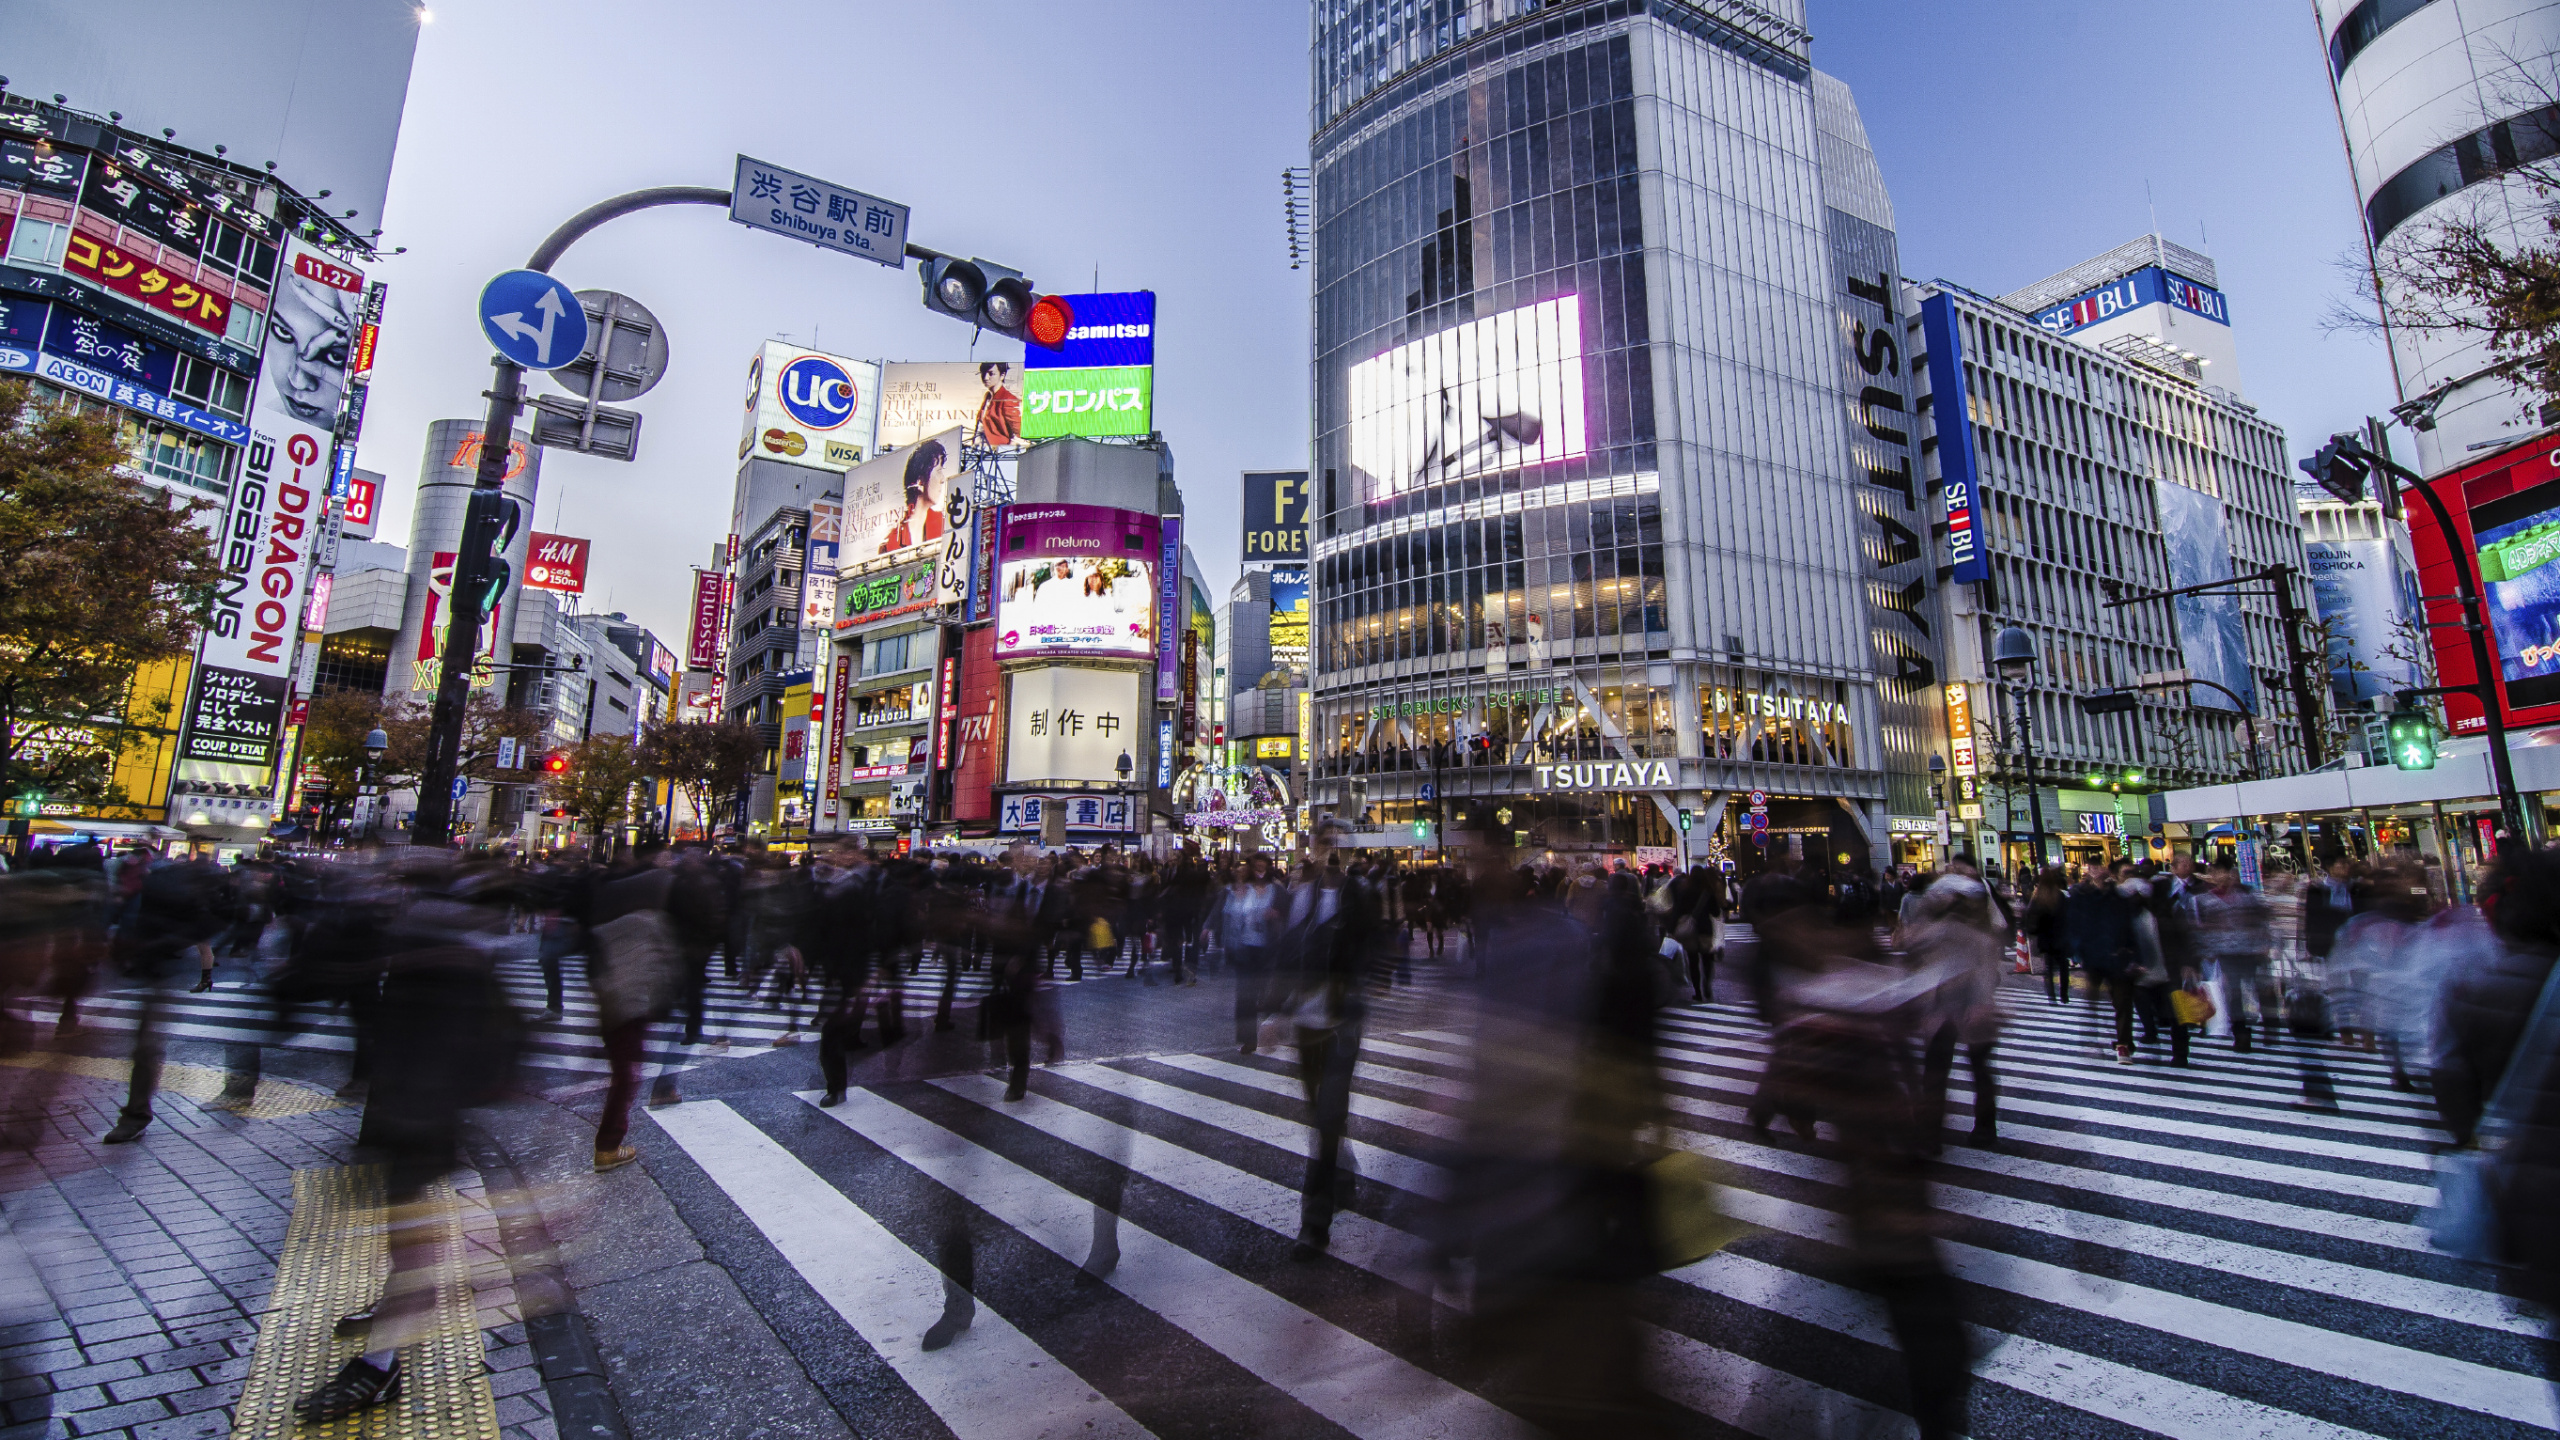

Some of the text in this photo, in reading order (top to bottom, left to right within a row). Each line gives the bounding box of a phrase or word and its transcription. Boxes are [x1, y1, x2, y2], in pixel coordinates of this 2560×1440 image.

[105, 166, 122, 178] 9F
[749, 169, 895, 238] 渋谷駅前
[770, 208, 875, 252] Shibuya Sta.
[28, 276, 48, 289] 7F
[68, 234, 223, 321] コンタクト
[305, 260, 352, 288] 11.27
[67, 286, 85, 299] 7F
[2167, 276, 2224, 321] SEIBU
[2040, 279, 2140, 333] SEIBU
[47, 360, 107, 393] AEON
[885, 381, 937, 393] 三浦大知
[788, 369, 851, 415] UC
[885, 393, 942, 401] NEW ALBUM
[885, 400, 917, 410] THE
[1028, 387, 1143, 414] サロンパス
[115, 383, 247, 440] 英会話イーオン
[254, 429, 276, 445] from
[764, 435, 807, 450] MasterCard
[829, 447, 861, 462] VISA
[1847, 271, 1936, 697] TSUTAYA
[1038, 510, 1067, 519] チャンネル
[1944, 481, 1976, 566] SEIBU
[245, 433, 319, 664] G-DRAGON
[323, 512, 341, 561] 渋谷駅前ビル
[941, 486, 970, 598] もんじゃ
[538, 539, 580, 566] H&M
[549, 576, 578, 588] 150m
[550, 568, 572, 577] この先
[814, 589, 835, 601] まで
[868, 583, 900, 610] 西村
[1160, 538, 1178, 652] Taisei neon
[691, 573, 719, 664] Essential
[1271, 654, 1291, 662] ALL
[205, 670, 257, 689] ジャパン
[199, 699, 241, 716] にして
[202, 685, 276, 706] ソロデビュー
[1372, 686, 1563, 721] STARBUCKS COFFEE
[858, 708, 910, 727] Euphoria
[1747, 693, 1852, 726] TSUTAYA
[195, 714, 272, 736] 完全ベスト!
[1030, 708, 1121, 739] 制作中
[191, 738, 268, 756] COUP D'ETAT
[1956, 749, 1972, 765] 本
[1537, 761, 1674, 789] TSUTAYA
[1005, 798, 1129, 824] 大盛書店
[2079, 812, 2124, 834] SEIBU
[1892, 818, 1931, 831] TSUTAYA
